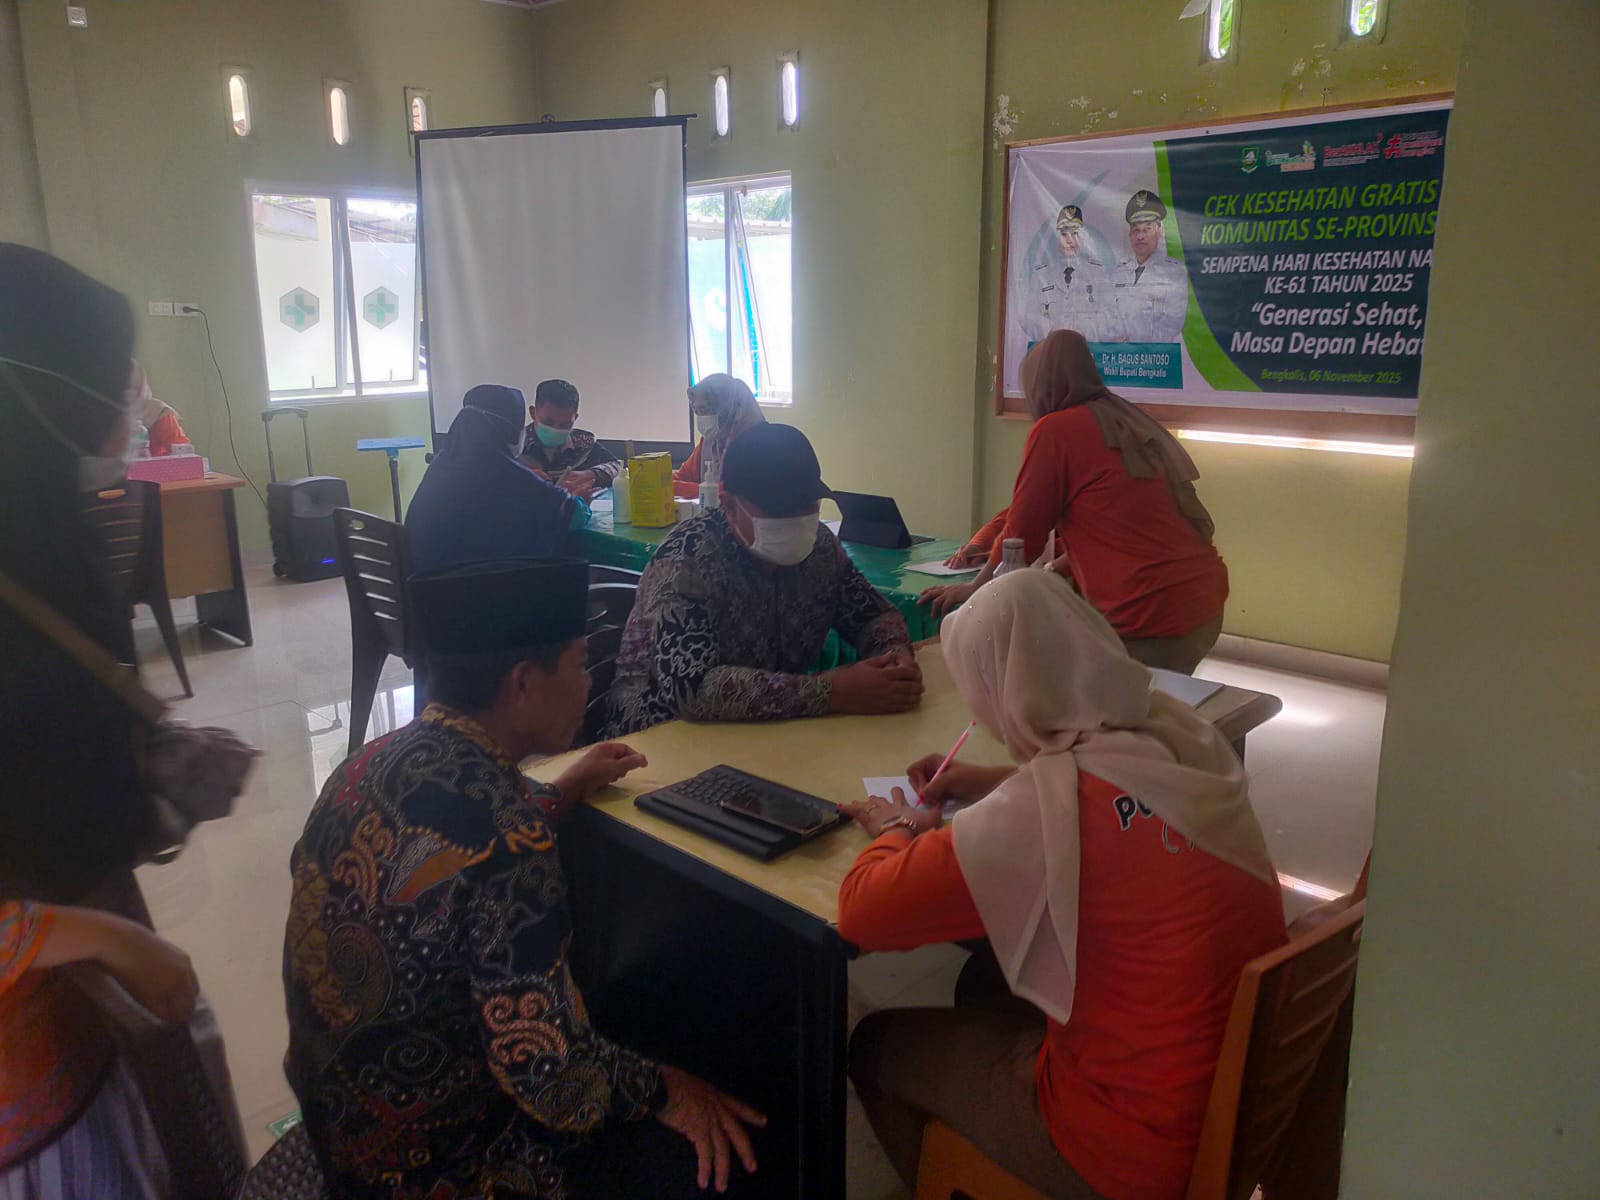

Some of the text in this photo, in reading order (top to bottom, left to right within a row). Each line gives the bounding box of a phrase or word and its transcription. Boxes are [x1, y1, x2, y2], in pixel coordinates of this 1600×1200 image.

[1204, 179, 1439, 217] CEK KESEHATAN GRATIS
[1201, 211, 1438, 245] KOMUNITAS SE-PROVINS
[1201, 256, 1269, 274] SEMPENA
[1272, 253, 1311, 272] HARI
[1312, 249, 1406, 271] KESEHATAN
[1264, 273, 1414, 294] KE-61 TAHUN 2025
[1352, 301, 1423, 330] Sehat,
[1230, 331, 1284, 353] Masa
[1288, 331, 1355, 359] Depan
[1118, 354, 1139, 365] BAGUS
[1140, 354, 1170, 366] SANTOSO
[1103, 367, 1167, 379] Wakil Bupati Bengkalis
[1260, 368, 1402, 384] Bengkalis, 06 November 2025
